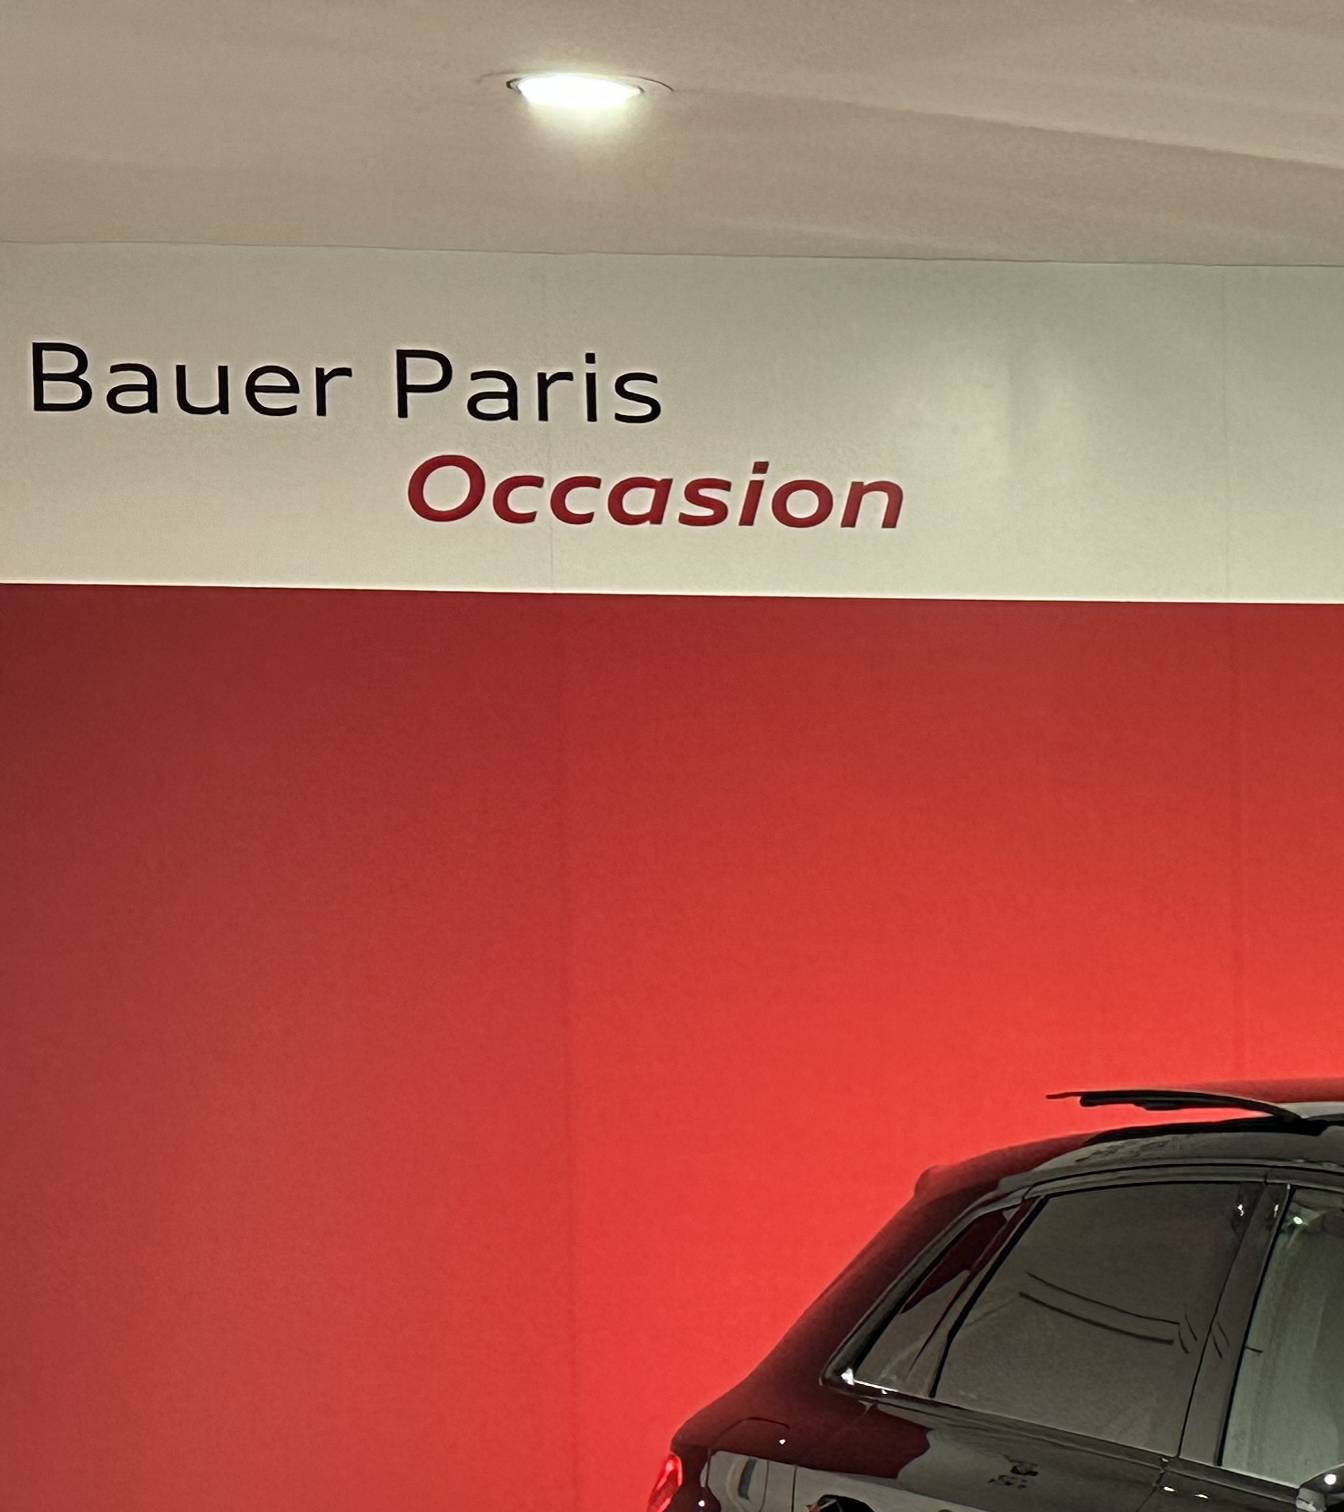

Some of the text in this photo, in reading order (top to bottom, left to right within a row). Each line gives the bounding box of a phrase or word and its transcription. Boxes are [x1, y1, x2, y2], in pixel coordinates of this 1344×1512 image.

[31, 341, 662, 424] Bauer Paris
[407, 455, 904, 529] Occasion
